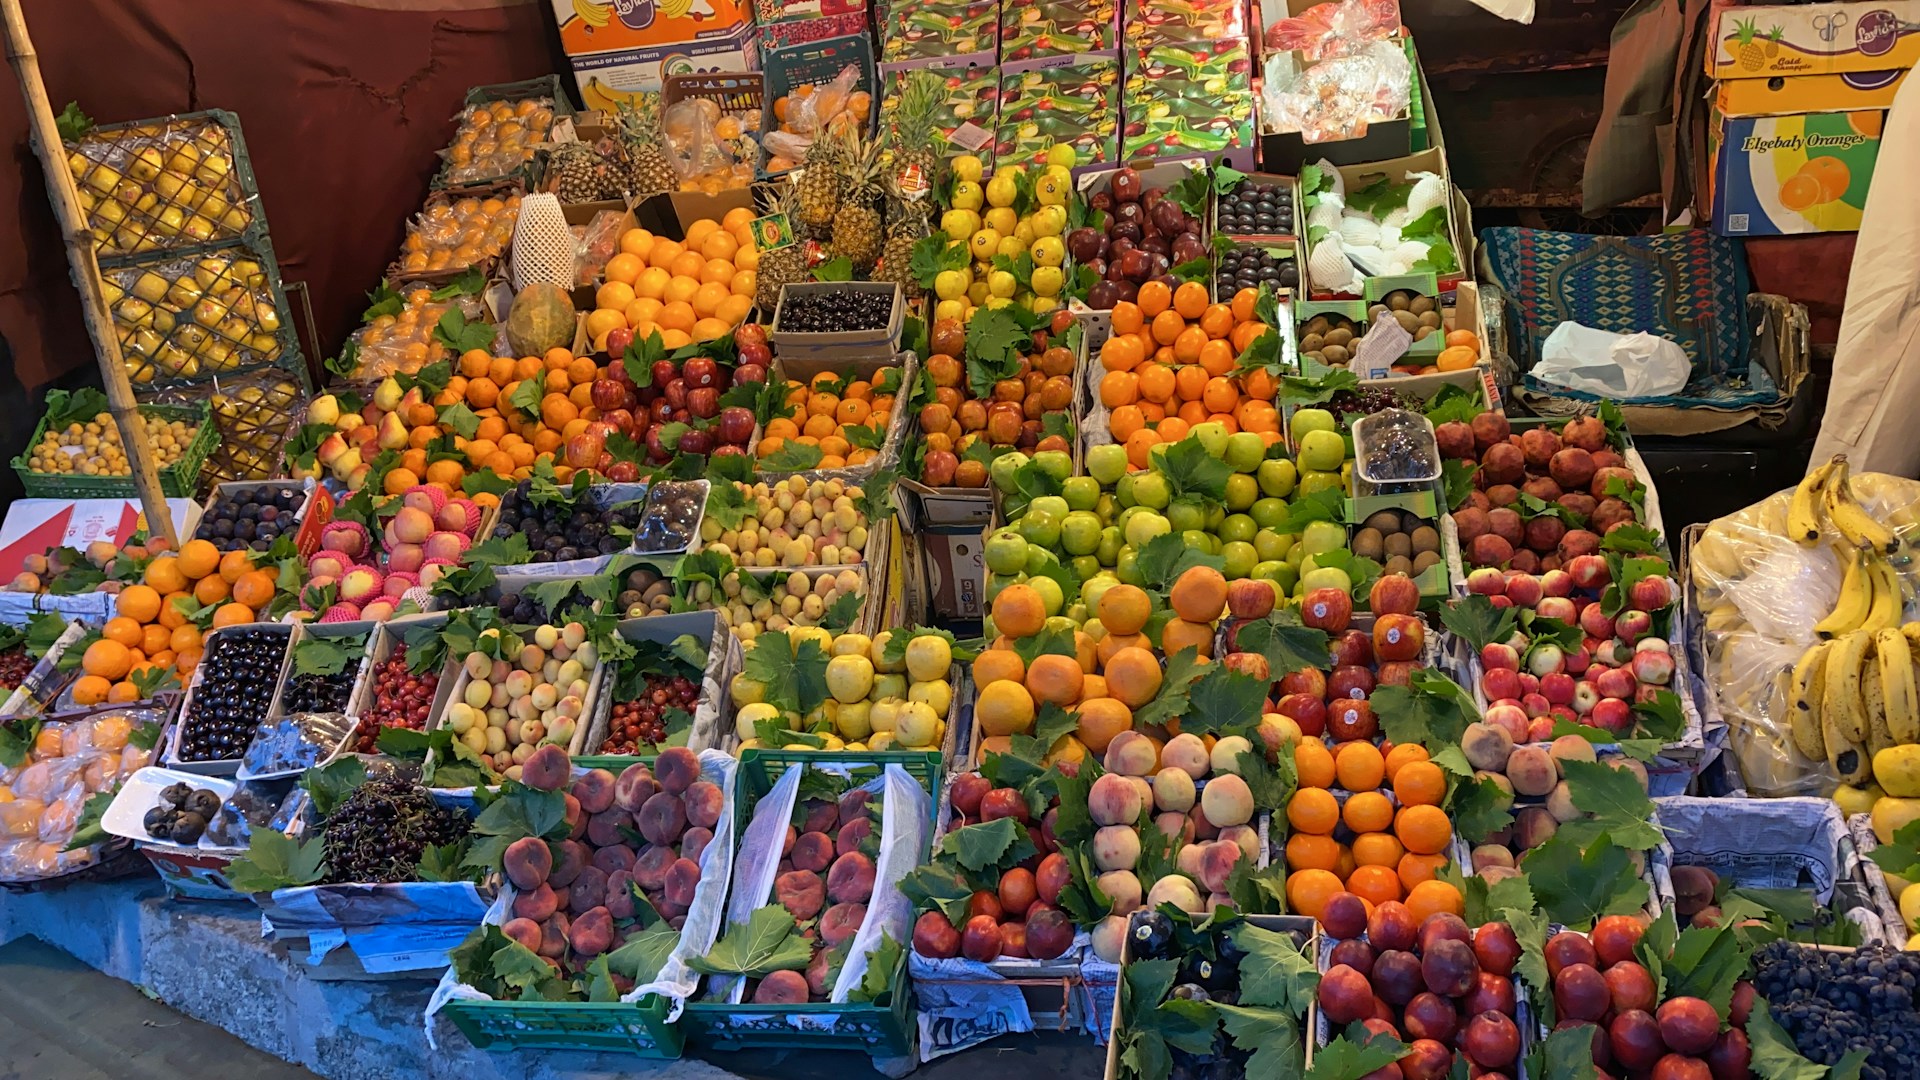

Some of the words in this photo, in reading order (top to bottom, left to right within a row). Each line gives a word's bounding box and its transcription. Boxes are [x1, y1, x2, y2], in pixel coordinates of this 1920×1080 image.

[585, 59, 605, 67] WORLD
[613, 55, 639, 63] NATURAL
[640, 52, 660, 60] FRUITS
[1743, 135, 1804, 153] Elgebaly
[1806, 133, 1866, 148] Oranges
